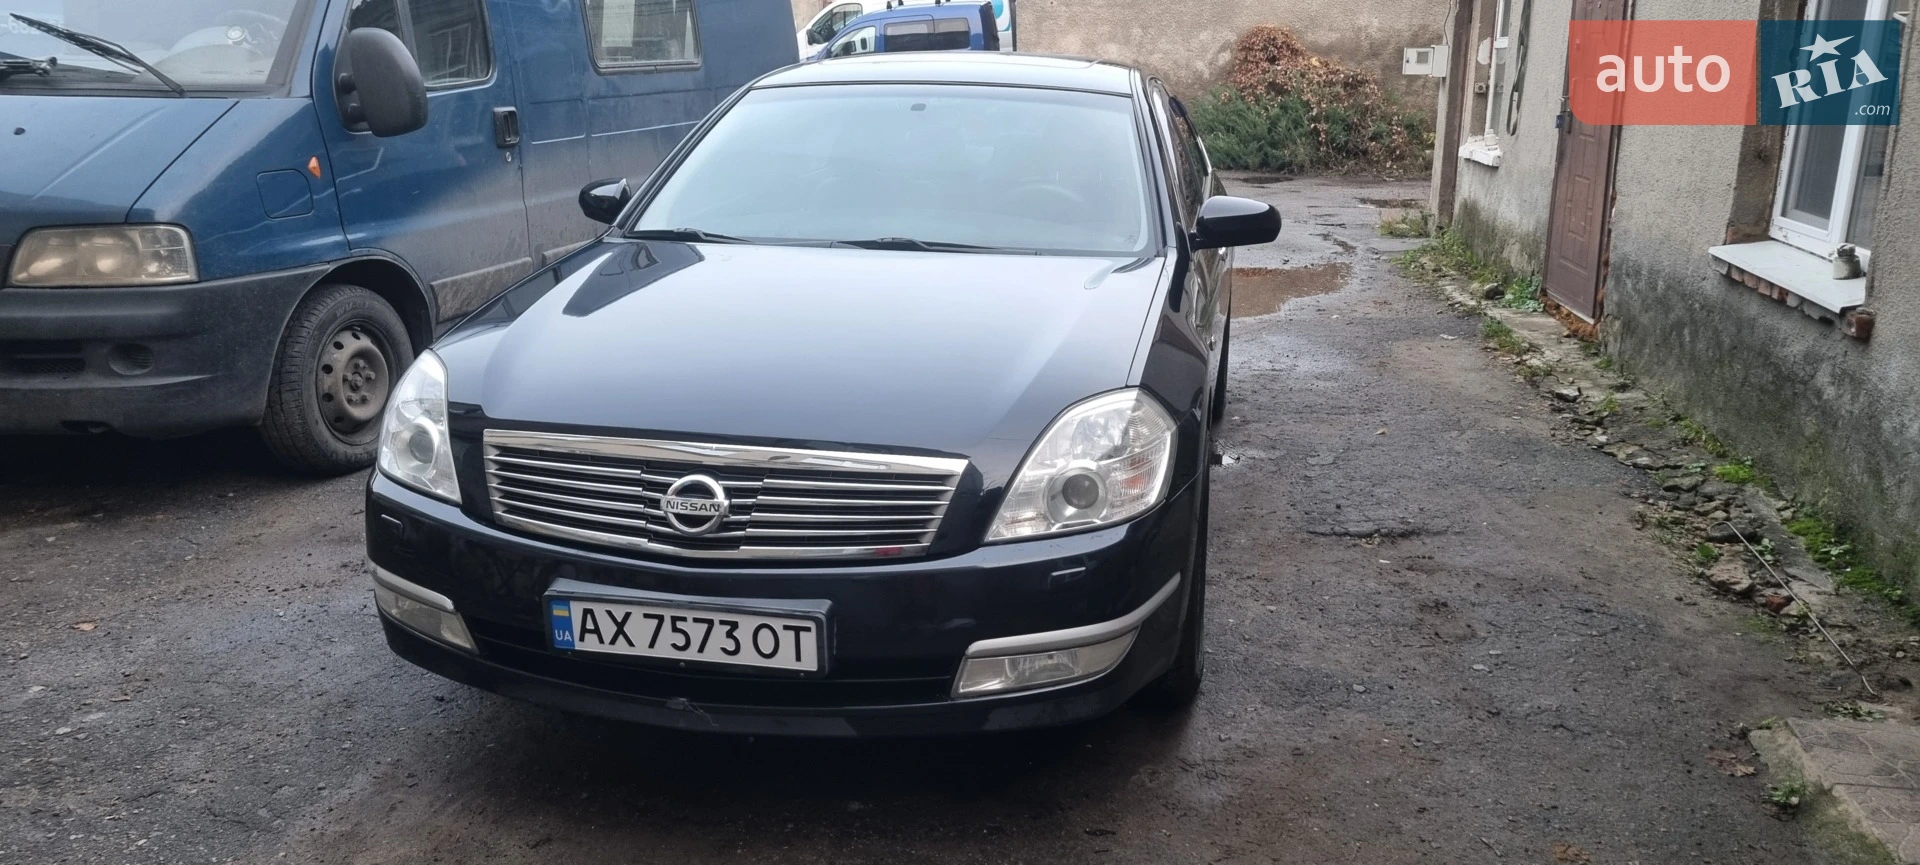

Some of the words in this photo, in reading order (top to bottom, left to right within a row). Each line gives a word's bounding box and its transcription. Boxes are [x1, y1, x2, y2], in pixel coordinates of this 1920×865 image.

[665, 500, 720, 513] NISSAN
[555, 629, 572, 642] UA
[578, 607, 636, 648] AX
[642, 612, 742, 657] 7573
[752, 622, 812, 662] OT
